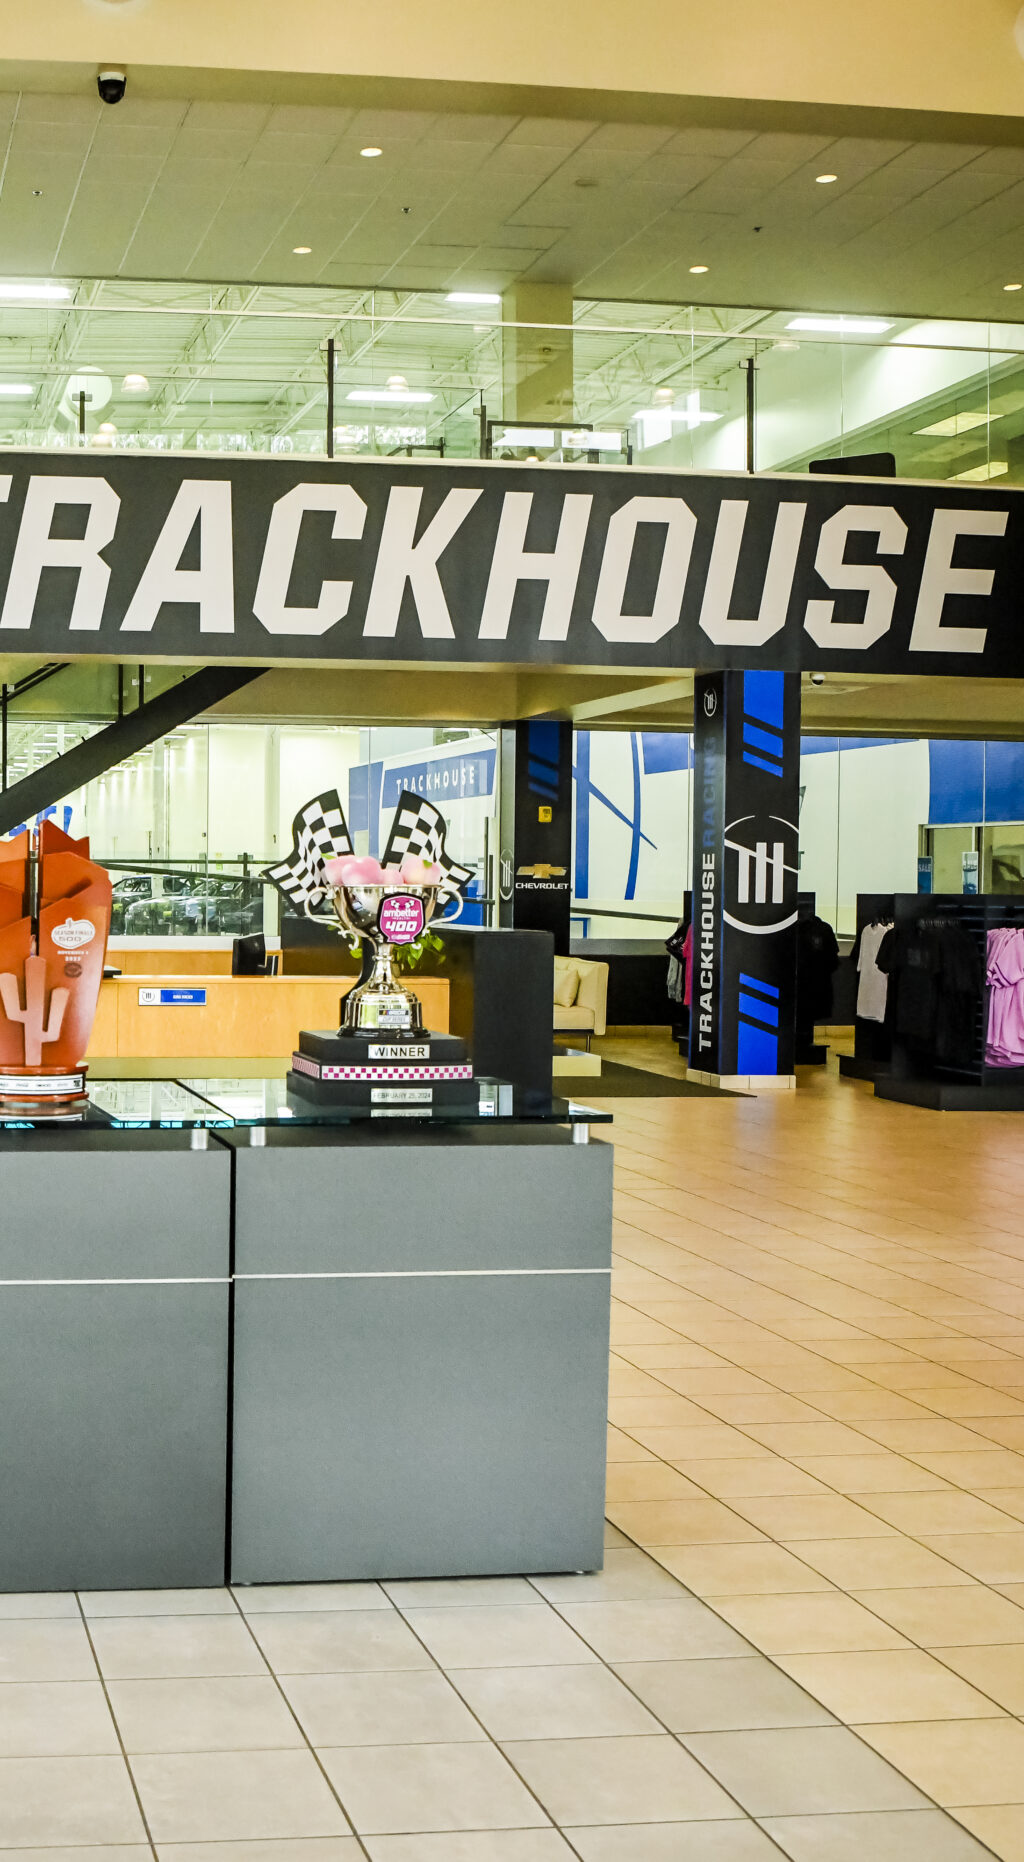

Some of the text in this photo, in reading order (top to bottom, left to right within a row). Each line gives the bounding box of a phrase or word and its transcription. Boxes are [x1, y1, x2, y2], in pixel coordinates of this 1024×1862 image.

[396, 766, 475, 795] TRACKHOUSE
[515, 882, 569, 890] CHEVROLET
[699, 737, 718, 1052] TRACKHOUSE RACING
[383, 909, 420, 917] ambetter
[386, 921, 418, 932] 400
[375, 1047, 425, 1057] WINNER
